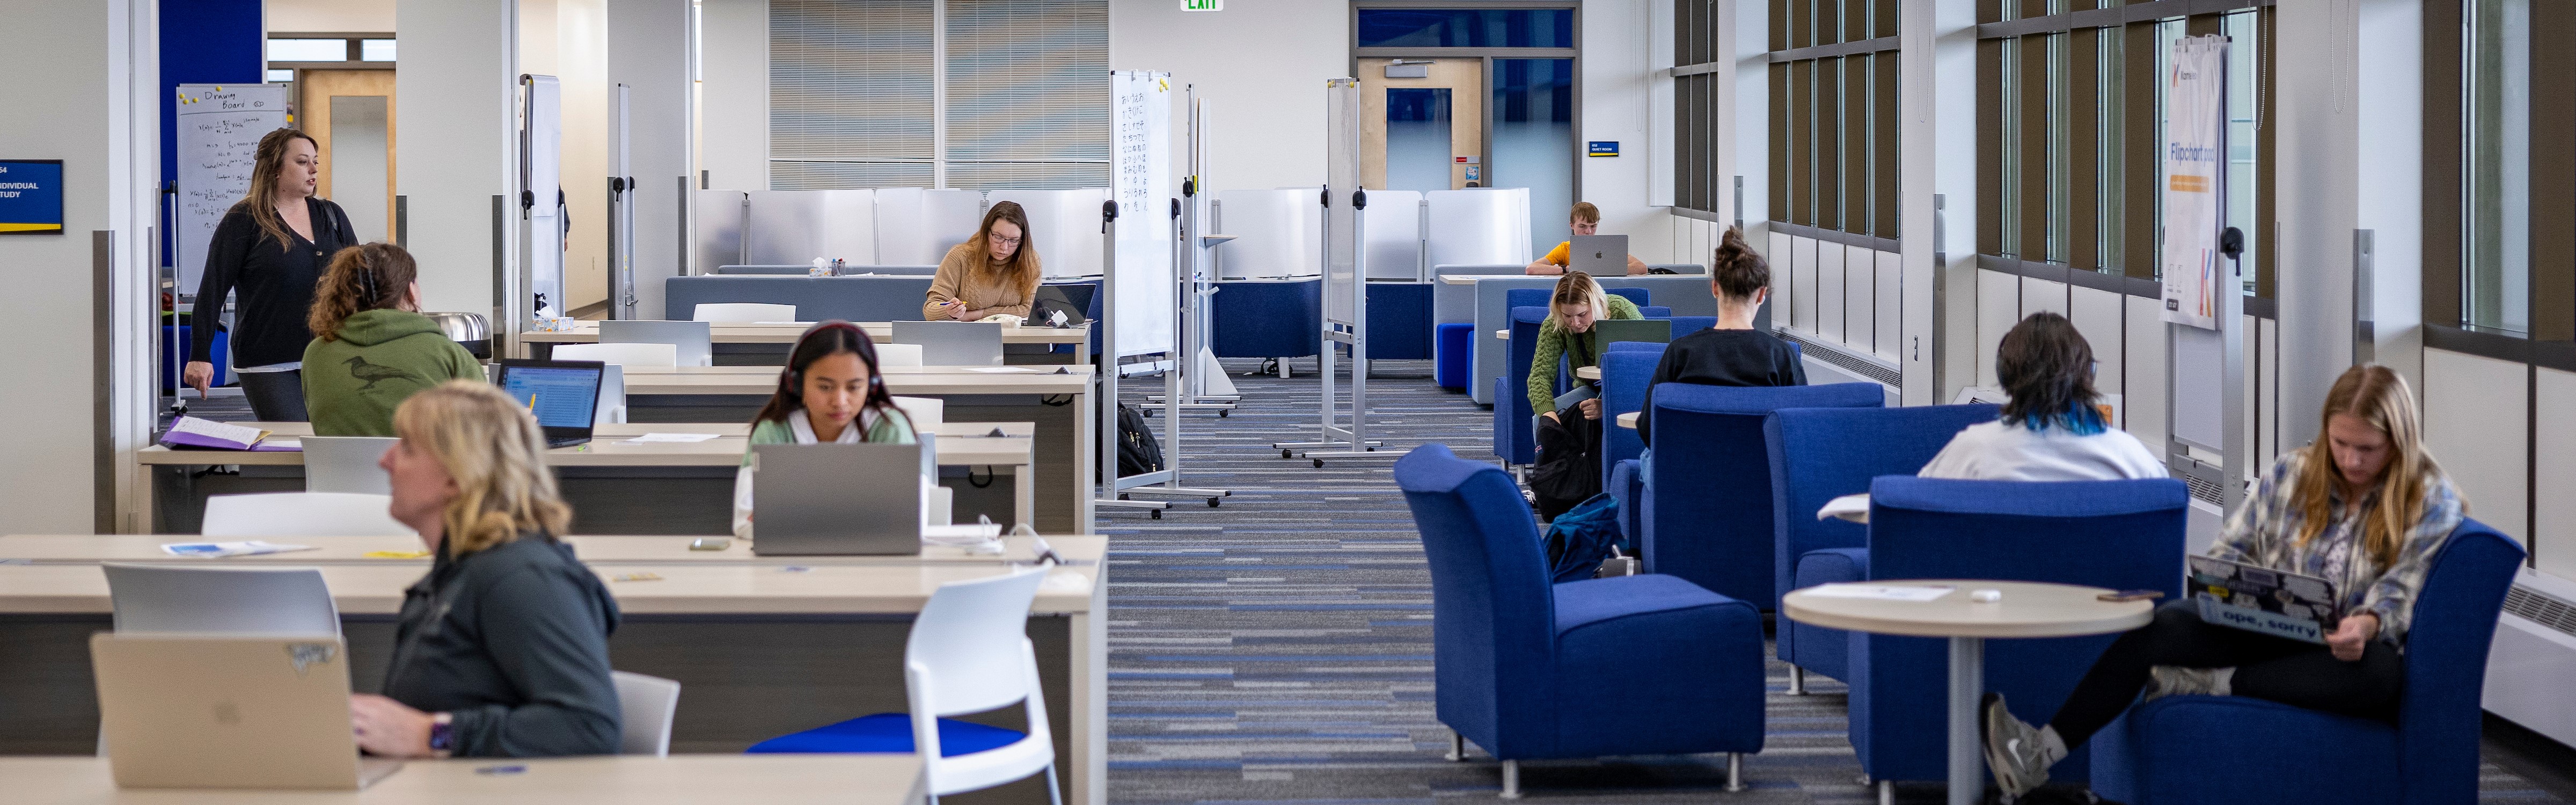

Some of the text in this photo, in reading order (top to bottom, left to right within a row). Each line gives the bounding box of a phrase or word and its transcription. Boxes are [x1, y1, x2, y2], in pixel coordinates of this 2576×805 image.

[204, 91, 236, 100] Drawing
[223, 98, 245, 109] Board
[2171, 142, 2202, 166] Flipchart
[2223, 610, 2317, 638] ope, sorry
